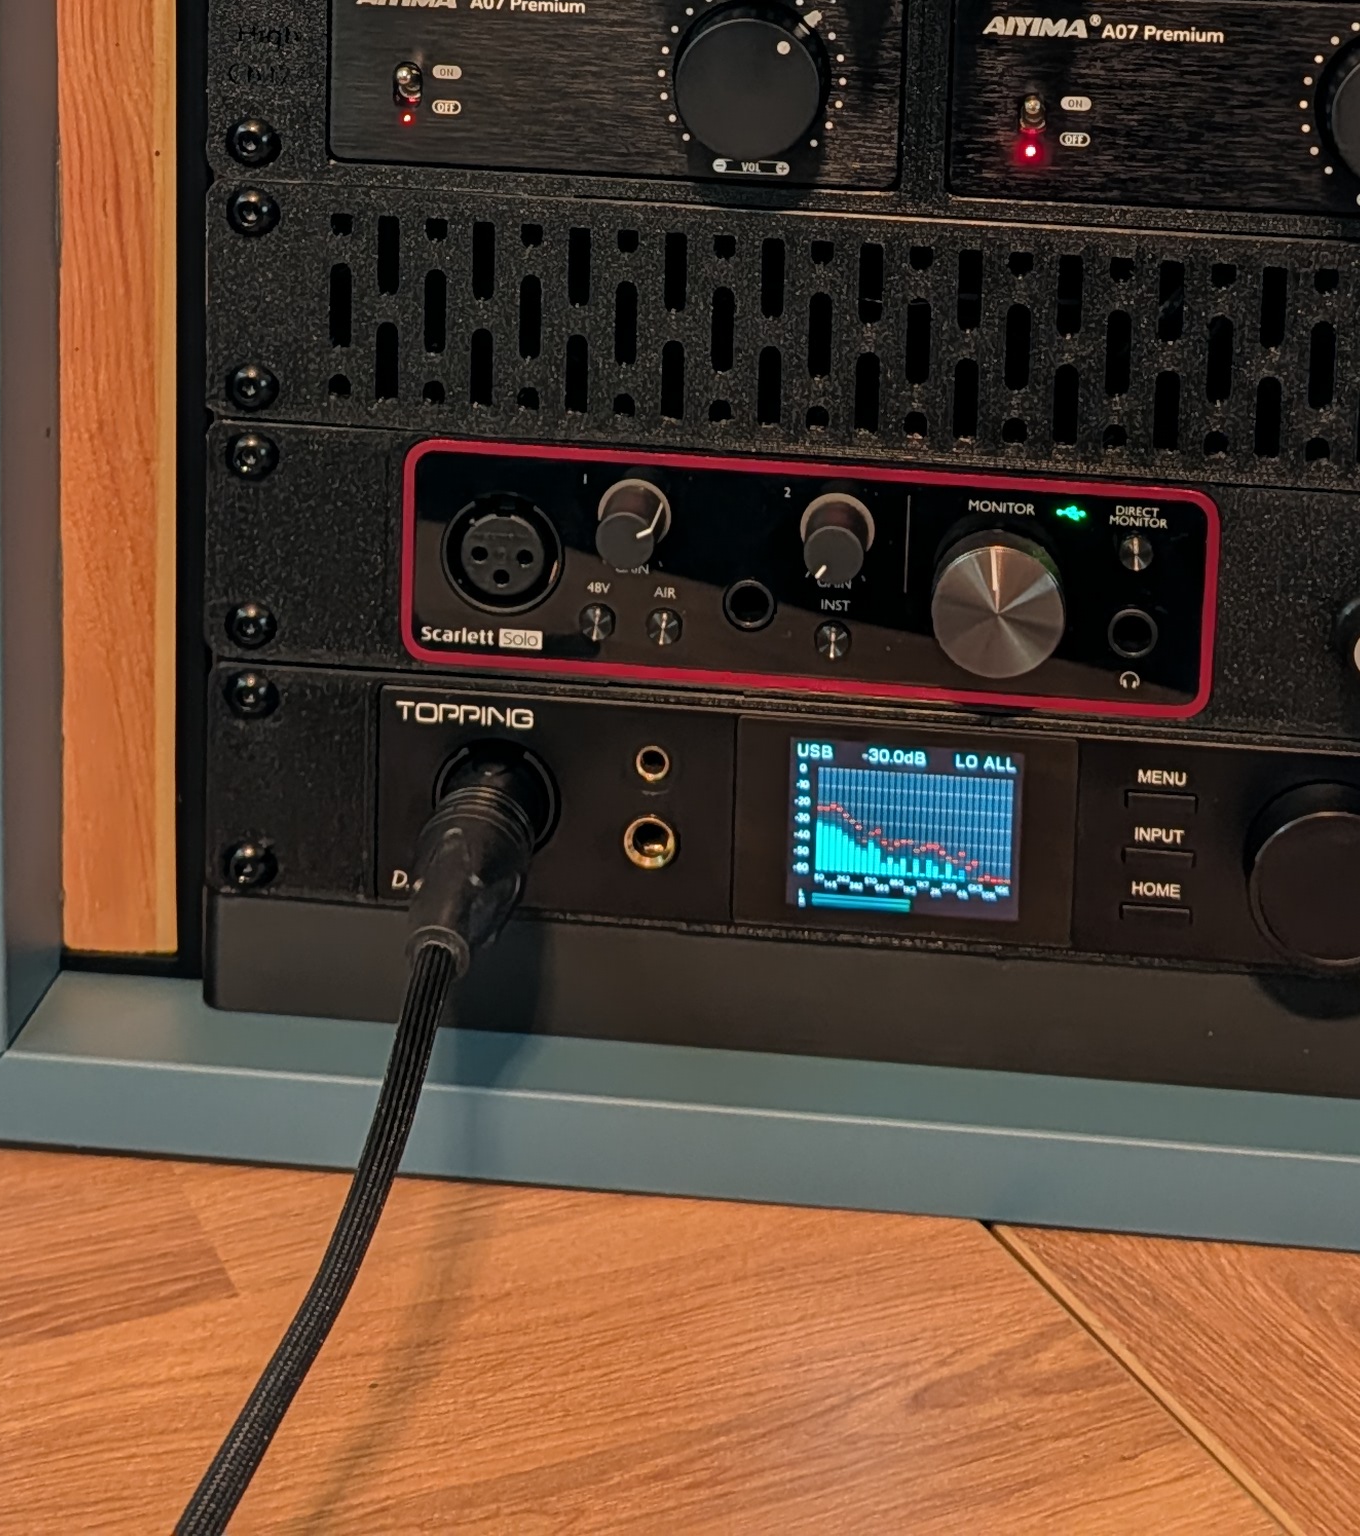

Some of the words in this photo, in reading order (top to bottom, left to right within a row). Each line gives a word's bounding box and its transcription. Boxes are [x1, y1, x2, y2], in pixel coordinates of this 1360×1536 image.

[1101, 23, 1138, 40] A07
[1144, 25, 1225, 44] Premium
[439, 67, 454, 78] ON
[436, 102, 456, 113] OFF
[1067, 98, 1083, 109] ON
[1064, 134, 1084, 146] OFF
[741, 161, 762, 173] VOL
[784, 487, 791, 498] 2
[968, 499, 1035, 516] MONITOR
[1115, 505, 1160, 518] DIRECT
[1109, 515, 1168, 529] MONITOR
[587, 581, 611, 594] 48V
[653, 586, 677, 600] AIR
[820, 598, 851, 612] INST
[421, 626, 494, 646] Scarlett
[503, 631, 539, 647] Solo
[396, 700, 534, 730] TOPPING
[797, 743, 834, 760] USB
[861, 748, 927, 767] -30.0dB
[955, 754, 978, 770] LO
[983, 756, 1017, 774] ALL
[1137, 769, 1187, 787] MENU
[1134, 826, 1185, 845] INPUT
[1131, 880, 1181, 900] HOME
